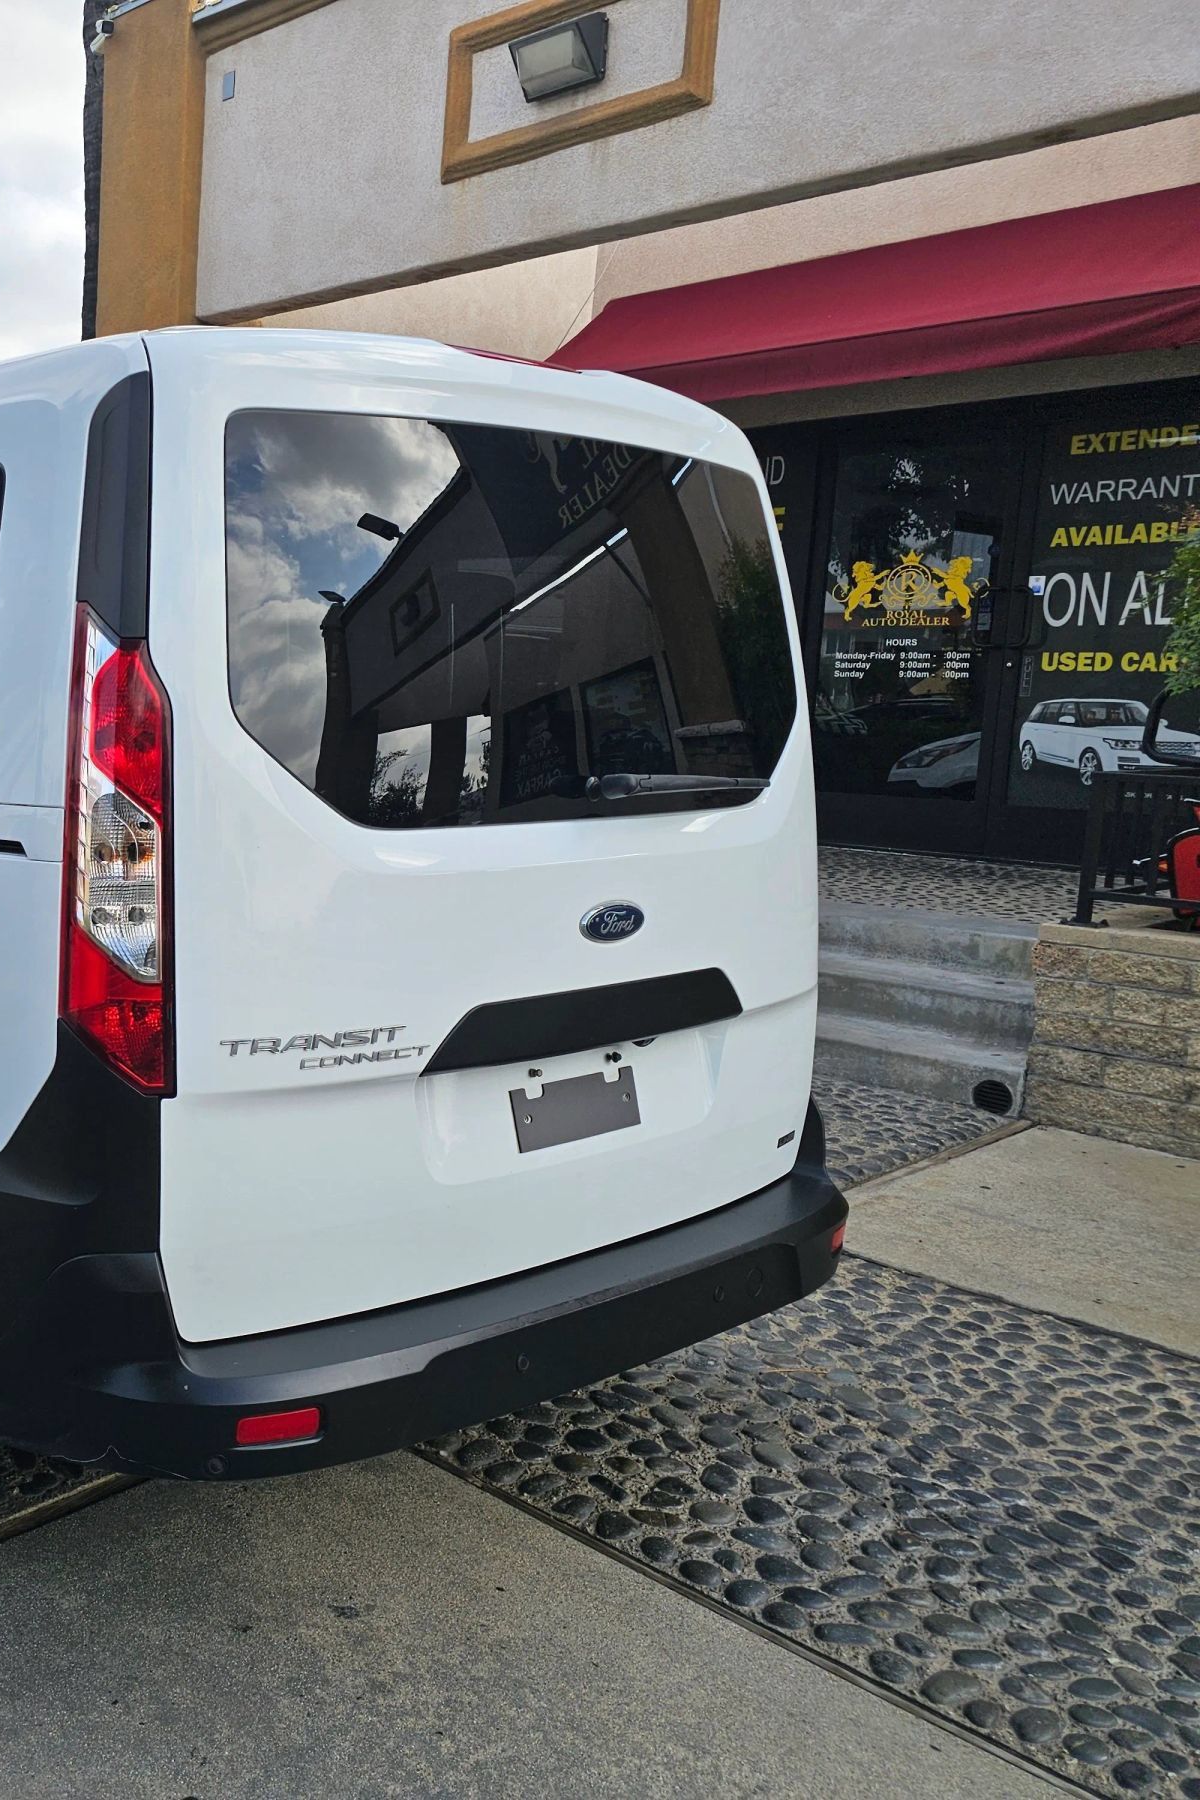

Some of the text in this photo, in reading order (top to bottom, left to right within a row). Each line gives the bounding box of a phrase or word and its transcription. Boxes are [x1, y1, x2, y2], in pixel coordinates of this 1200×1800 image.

[1050, 473, 1200, 505] WARRANT
[1043, 571, 1111, 627] ON
[886, 609, 927, 619] ROYAL
[862, 617, 950, 627] AUTO DEALER
[885, 638, 918, 647] HOURS
[835, 652, 896, 661] Monday-Friday
[900, 651, 931, 660] 9:00am
[1041, 652, 1180, 672] USED CAR
[834, 661, 871, 670] Saturday
[899, 660, 930, 669] 9:00am
[833, 670, 865, 679] Sunday
[898, 670, 930, 678] 9:00am
[600, 911, 635, 935] Ford
[220, 1025, 407, 1057] TRANSIT
[299, 1044, 432, 1071] CONNECT
